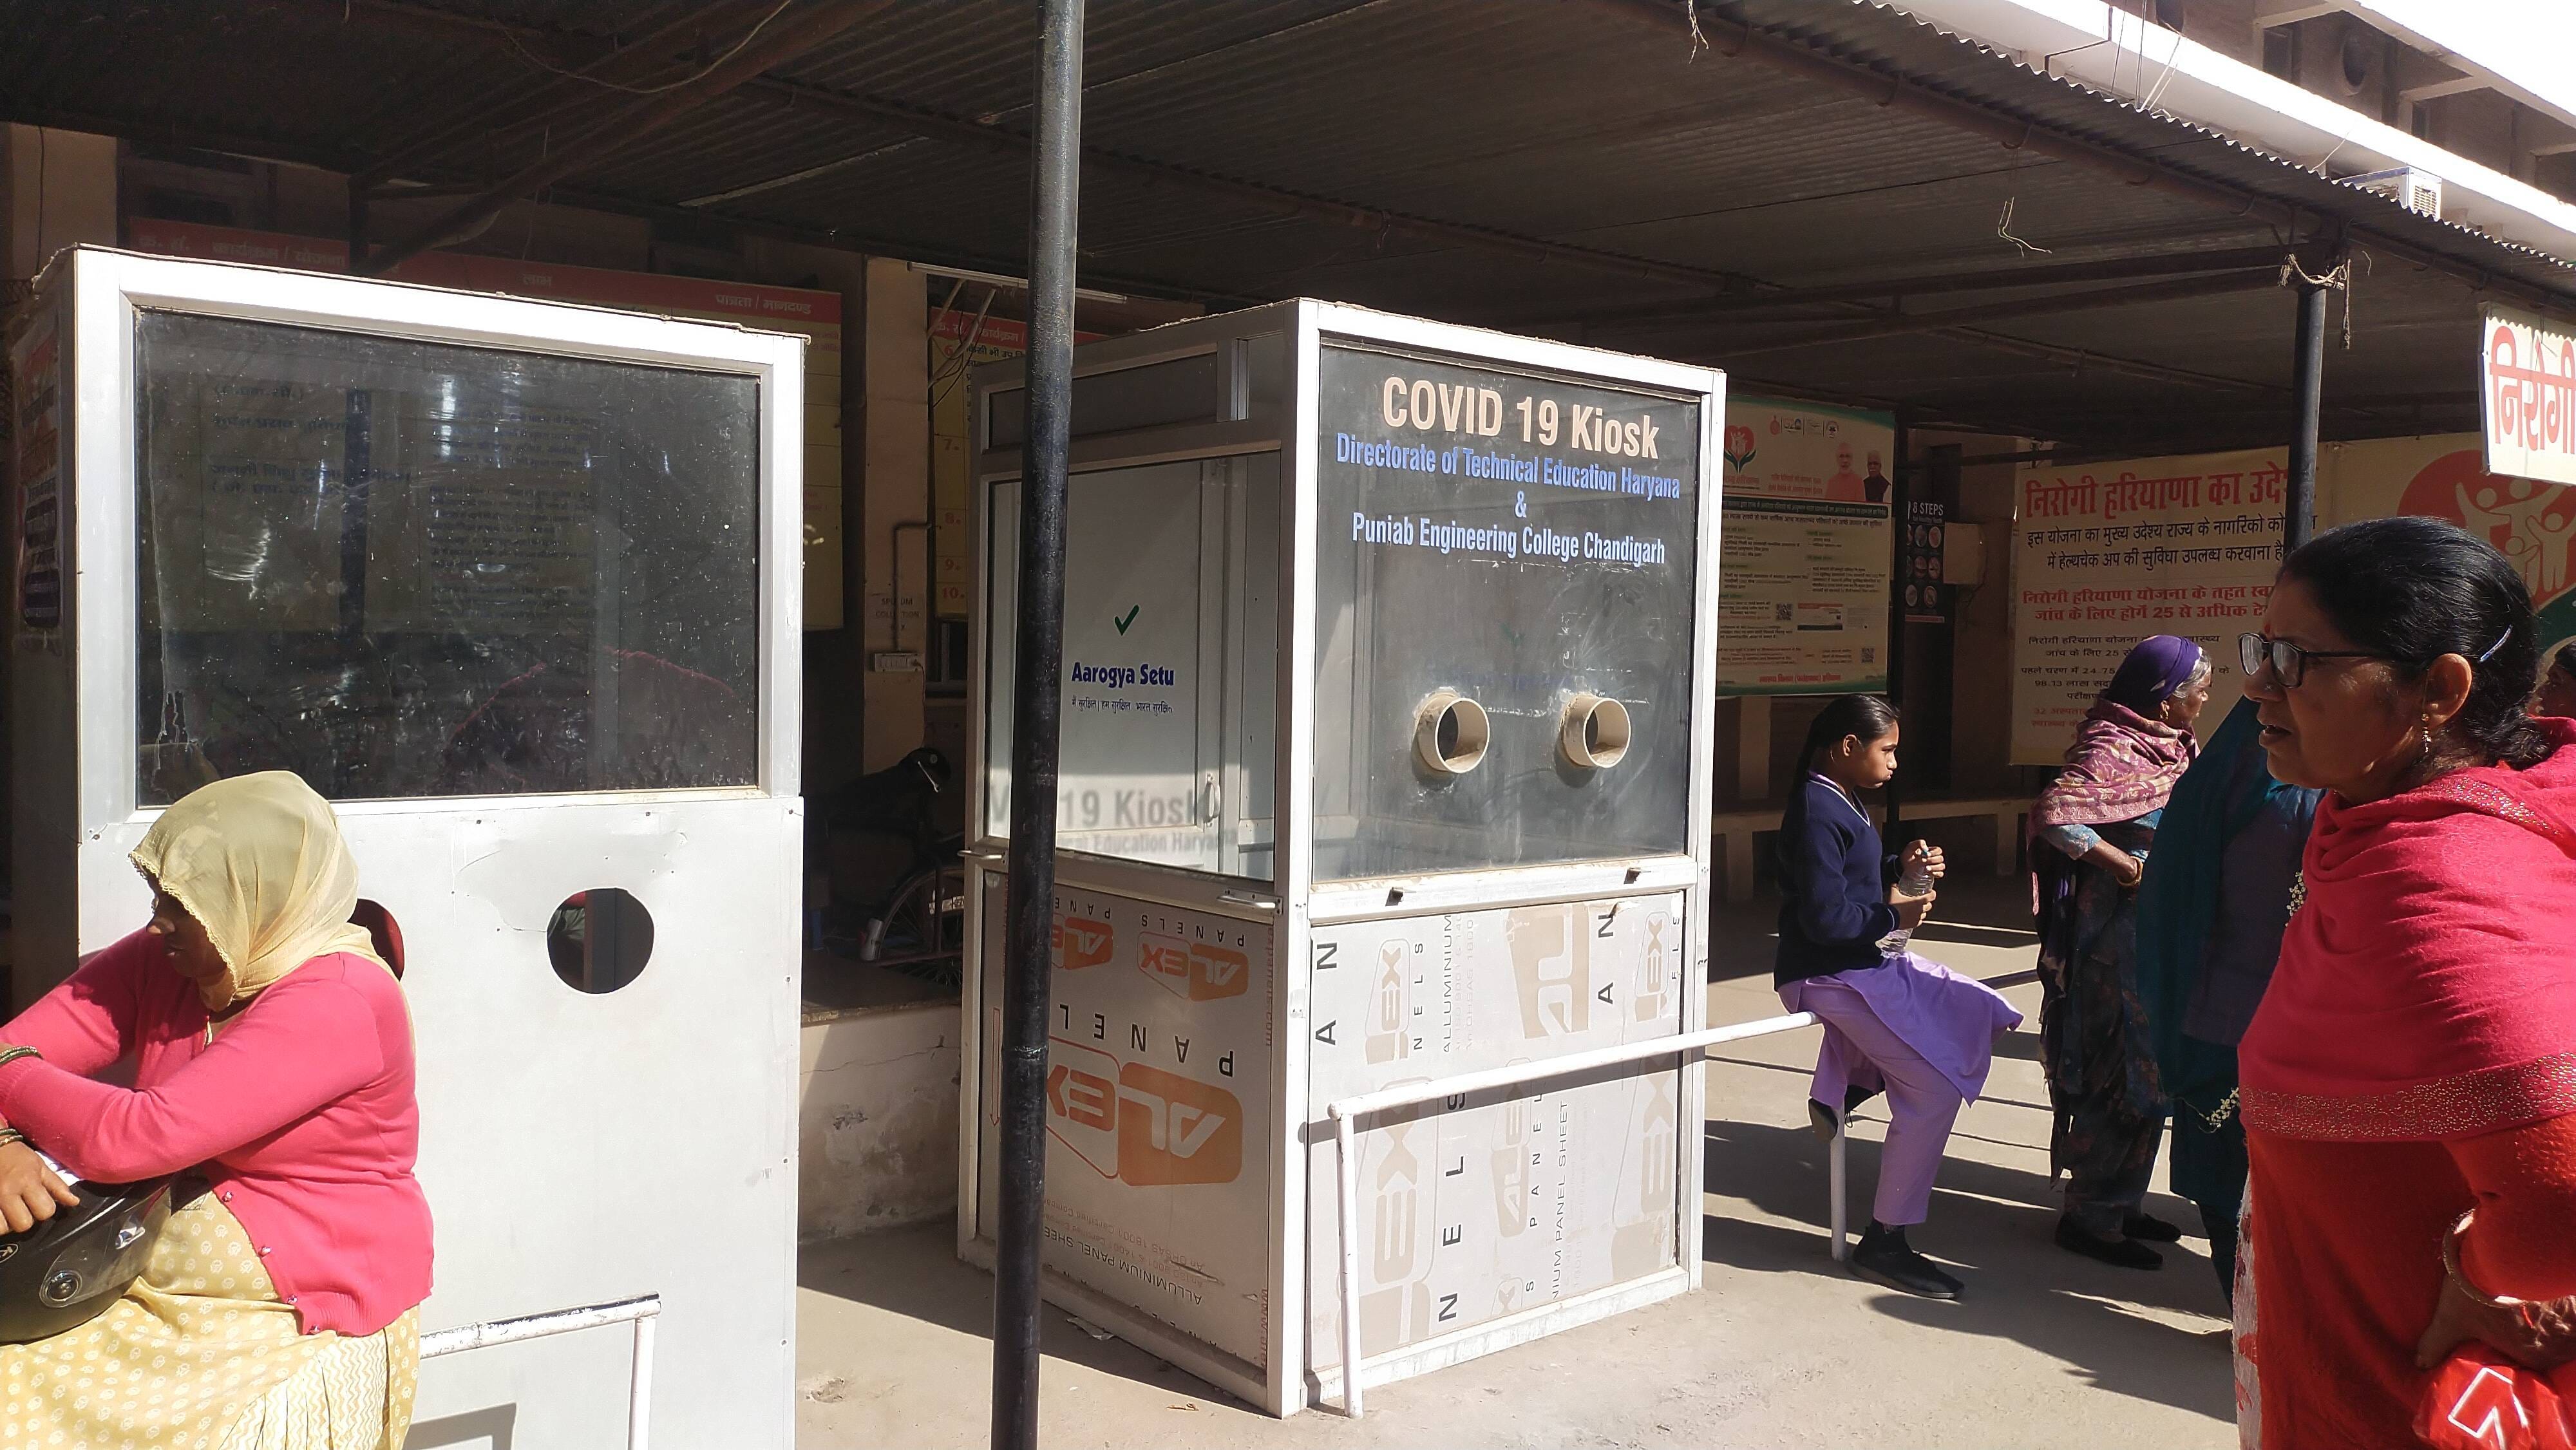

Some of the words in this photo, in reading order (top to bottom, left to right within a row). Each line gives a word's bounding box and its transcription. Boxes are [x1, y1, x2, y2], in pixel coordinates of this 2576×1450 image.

[2489, 326, 2576, 455] निरोगी
[1383, 377, 1503, 437] COVID
[1517, 395, 1558, 446] 19
[1571, 404, 1660, 460] Kiosk
[1336, 432, 1436, 473] Directorate
[1441, 446, 1459, 475] of
[1463, 447, 1539, 484] Technical
[1543, 457, 1616, 492] Education
[1620, 466, 1680, 502] Haryana
[1515, 490, 1528, 518] &
[1913, 501, 1918, 514] 8
[1920, 502, 1944, 516] STEPS
[2025, 474, 2098, 518] निरोगी
[2103, 471, 2201, 520] हरियाणा
[2208, 471, 2244, 506] का
[1419, 518, 1517, 559] Engineering
[1522, 524, 1579, 562] College
[1583, 530, 1665, 568] Chandigarh
[2027, 530, 2043, 549] इस
[2048, 525, 2081, 543] योजना
[2085, 527, 2099, 541] का
[2103, 525, 2129, 547] मुख्य
[2166, 520, 2195, 538] राज्य
[2198, 516, 2210, 535] के
[2268, 511, 2286, 532] को
[2047, 549, 2056, 569] में
[2059, 551, 2099, 571] हेल्थचेक
[2103, 552, 2120, 567] अप
[2125, 547, 2139, 566] की
[2226, 545, 2270, 562] करवाना
[2023, 588, 2069, 603] निरोगी
[2072, 588, 2132, 605] हरियाणा
[2137, 586, 2187, 601] योजना
[2192, 585, 2208, 599] के
[2211, 585, 2246, 601] तहत
[2251, 585, 2274, 598] स्वा
[2035, 607, 2063, 621] जांच
[2068, 607, 2082, 620] के
[2087, 606, 2116, 620] लिए
[2154, 607, 2174, 618] 25
[2179, 604, 2192, 618] से
[2197, 603, 2248, 619] अधिक
[2253, 603, 2267, 617] टे
[2029, 636, 2058, 645] निरोगी
[2062, 636, 2101, 644] हरियाणा
[2046, 648, 2066, 657] जांच
[2069, 648, 2079, 657] के
[2083, 648, 2101, 657] लिए
[1072, 661, 1135, 689] Aarogya
[1139, 663, 1175, 686] Setu
[2070, 665, 2079, 674] में
[2219, 666, 2231, 675] के
[1101, 700, 1110, 709] हम
[1112, 699, 1130, 714] सुरक्षित
[1136, 702, 1151, 711] भारत
[1141, 913, 1245, 947] PANELS
[1140, 942, 1243, 986] ALEX
[1443, 915, 1452, 1053] ALLUMINIUM
[1059, 1004, 1234, 1078] PANEL
[1558, 1100, 1569, 1169] SHEET
[1530, 1093, 1543, 1228] PANEL
[1555, 1174, 1566, 1241] PANEL
[1044, 1225, 1074, 1249] SHEE
[1078, 1240, 1115, 1267] PANEL
[1119, 1259, 1202, 1306] ALLUMINIUM
